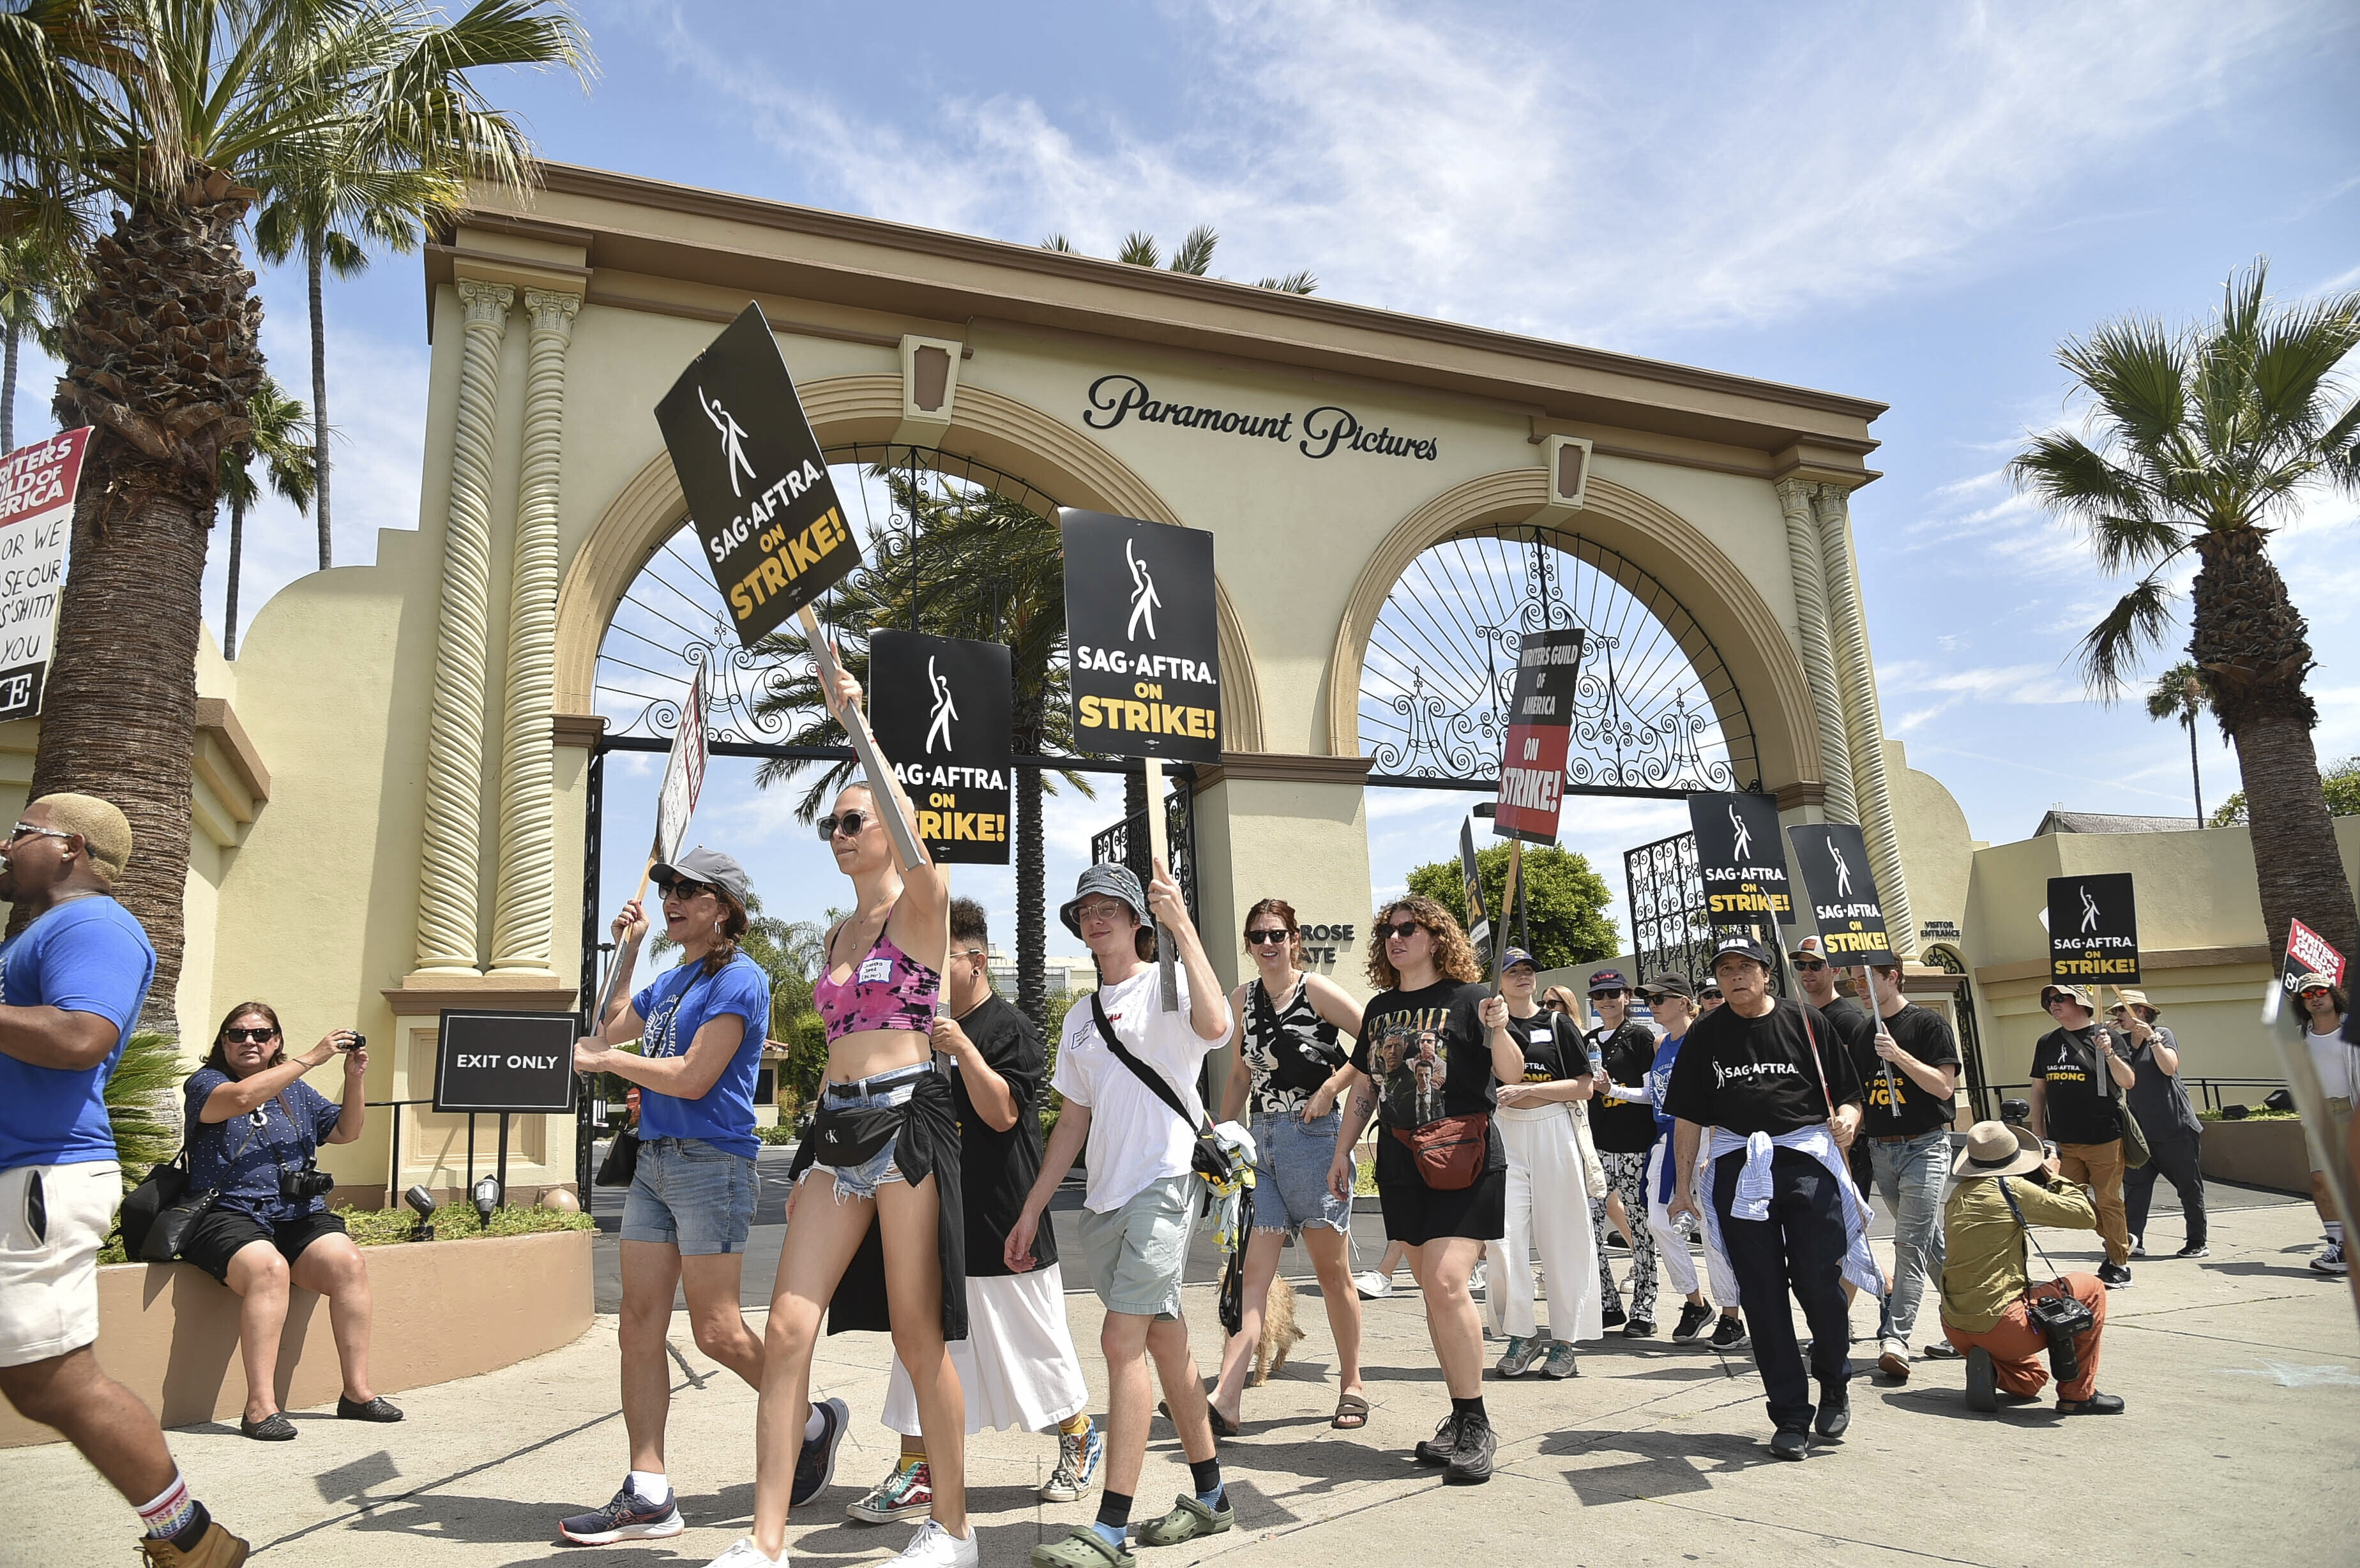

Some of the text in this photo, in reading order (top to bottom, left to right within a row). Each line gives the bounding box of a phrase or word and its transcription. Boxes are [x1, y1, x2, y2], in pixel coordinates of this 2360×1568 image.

[1084, 374, 1437, 461] Paramount Pictures
[0, 438, 73, 484] RITERS
[0, 465, 63, 501] ILD OF
[0, 480, 64, 520] ERICA
[35, 520, 64, 550] WE
[759, 523, 786, 552] ON
[730, 506, 846, 620] STRIKE!
[2, 559, 61, 598] SE OUR
[1, 635, 40, 664] YOU
[1521, 645, 1578, 668] WRITERS GUILD
[1135, 682, 1162, 700] ON
[1536, 673, 1547, 689] OF
[1079, 696, 1216, 739] STRIKE!
[1522, 696, 1555, 715] AMERICA
[1523, 737, 1540, 761] ON
[930, 793, 955, 808] ON
[1499, 767, 1561, 813] STRIKE!
[915, 811, 1005, 841] RIKE!
[1741, 884, 1757, 892] ON
[1709, 894, 1790, 912] STRIKE!
[1300, 924, 1355, 940] ROSE
[1849, 921, 1863, 931] ON
[1824, 932, 1889, 953] STRIKE!
[2296, 925, 2340, 967] WRITERS
[1300, 947, 1336, 963] ATE
[2055, 959, 2135, 974] STRIKE!
[2296, 937, 2337, 975] GUILD OF
[665, 1016, 677, 1057] AMERIC
[457, 1055, 559, 1069] EXIT ONLY
[1522, 1073, 1552, 1082] ONG
[2046, 1073, 2085, 1082] STRONG
